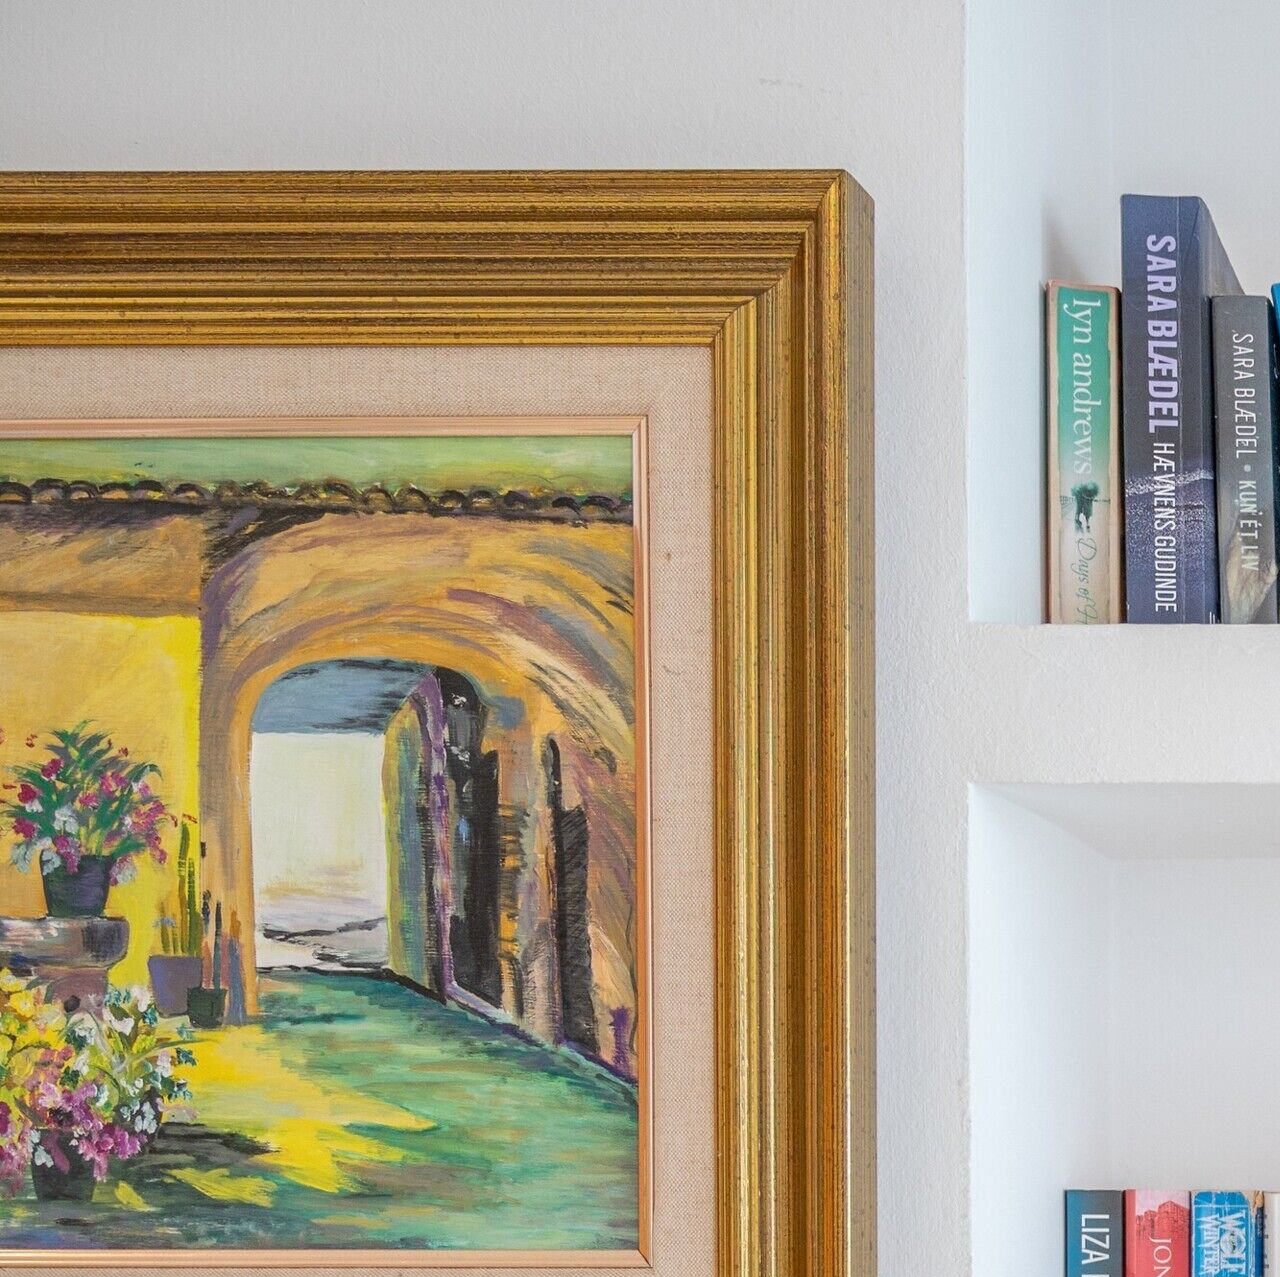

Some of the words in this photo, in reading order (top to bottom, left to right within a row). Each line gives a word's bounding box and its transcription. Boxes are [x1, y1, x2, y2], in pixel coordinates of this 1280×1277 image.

[1146, 234, 1176, 312] SARA
[1064, 297, 1101, 344] lyn
[1232, 334, 1255, 380] SARA
[1072, 353, 1099, 474] andrews
[1147, 320, 1178, 433] BLÆDEL
[1234, 388, 1257, 458] BLÆDEL
[1153, 443, 1176, 531] HÆVNENS
[1155, 536, 1176, 612] GUDINDE
[1081, 1213, 1110, 1263] LIZA
